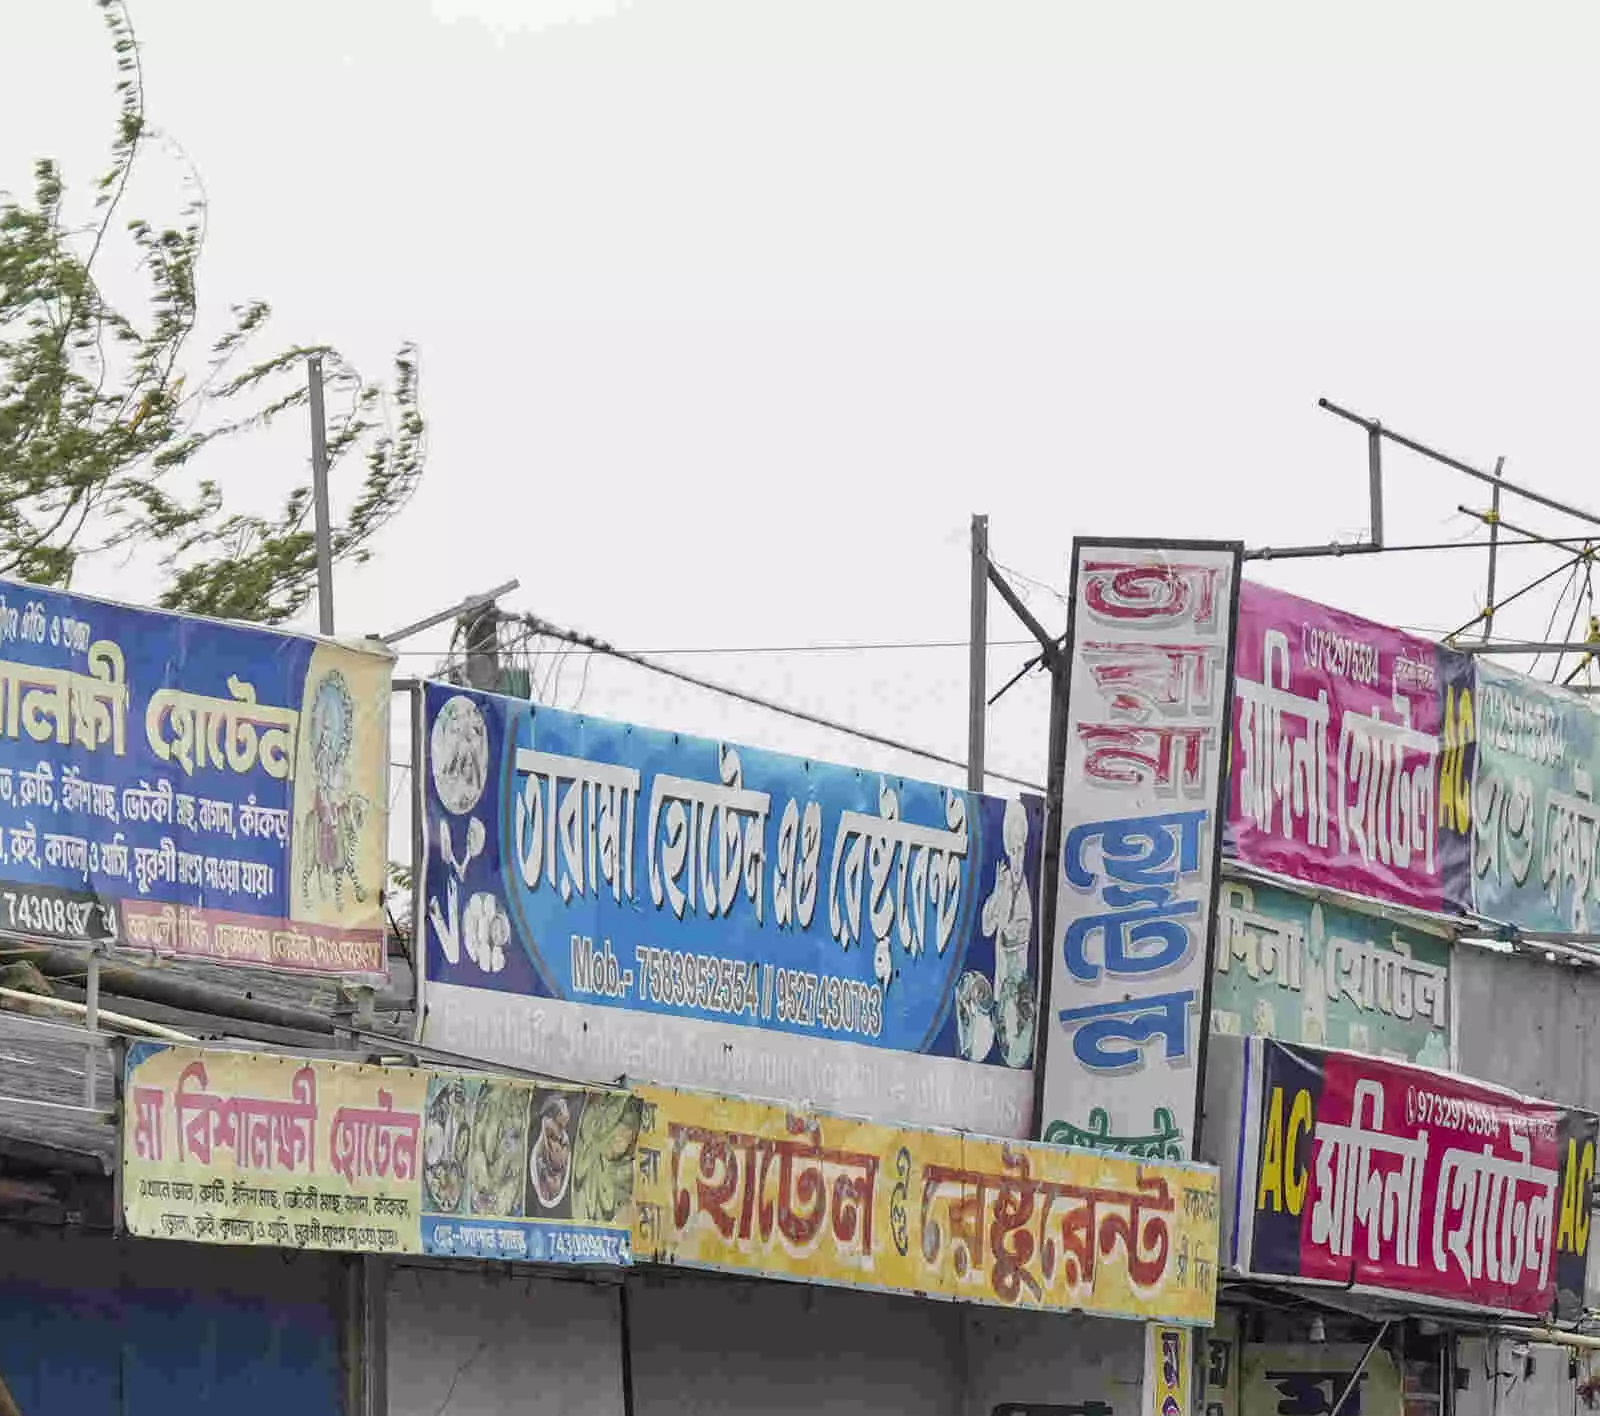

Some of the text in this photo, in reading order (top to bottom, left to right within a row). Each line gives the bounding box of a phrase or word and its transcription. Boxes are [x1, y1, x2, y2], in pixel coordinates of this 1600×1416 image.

[145, 673, 299, 782] হোটেল
[1337, 695, 1440, 877] হোটেল
[1439, 684, 1475, 836] AC
[515, 748, 642, 906] তারামা
[648, 752, 770, 927] হোটেল
[635, 945, 760, 1020] 7583952554
[774, 965, 884, 1038] 9527430733
[1058, 808, 1208, 1072] হোটেল
[1325, 928, 1450, 1030] হোটেল
[133, 1087, 165, 1162] মা
[330, 1086, 422, 1186] হোটেল
[1257, 1086, 1312, 1217] AC
[1418, 1090, 1500, 1138] 9732975584
[667, 1110, 881, 1260] হোটেল
[1312, 1077, 1560, 1292] মদিনা হোটেল
[1557, 1137, 1595, 1257] AC
